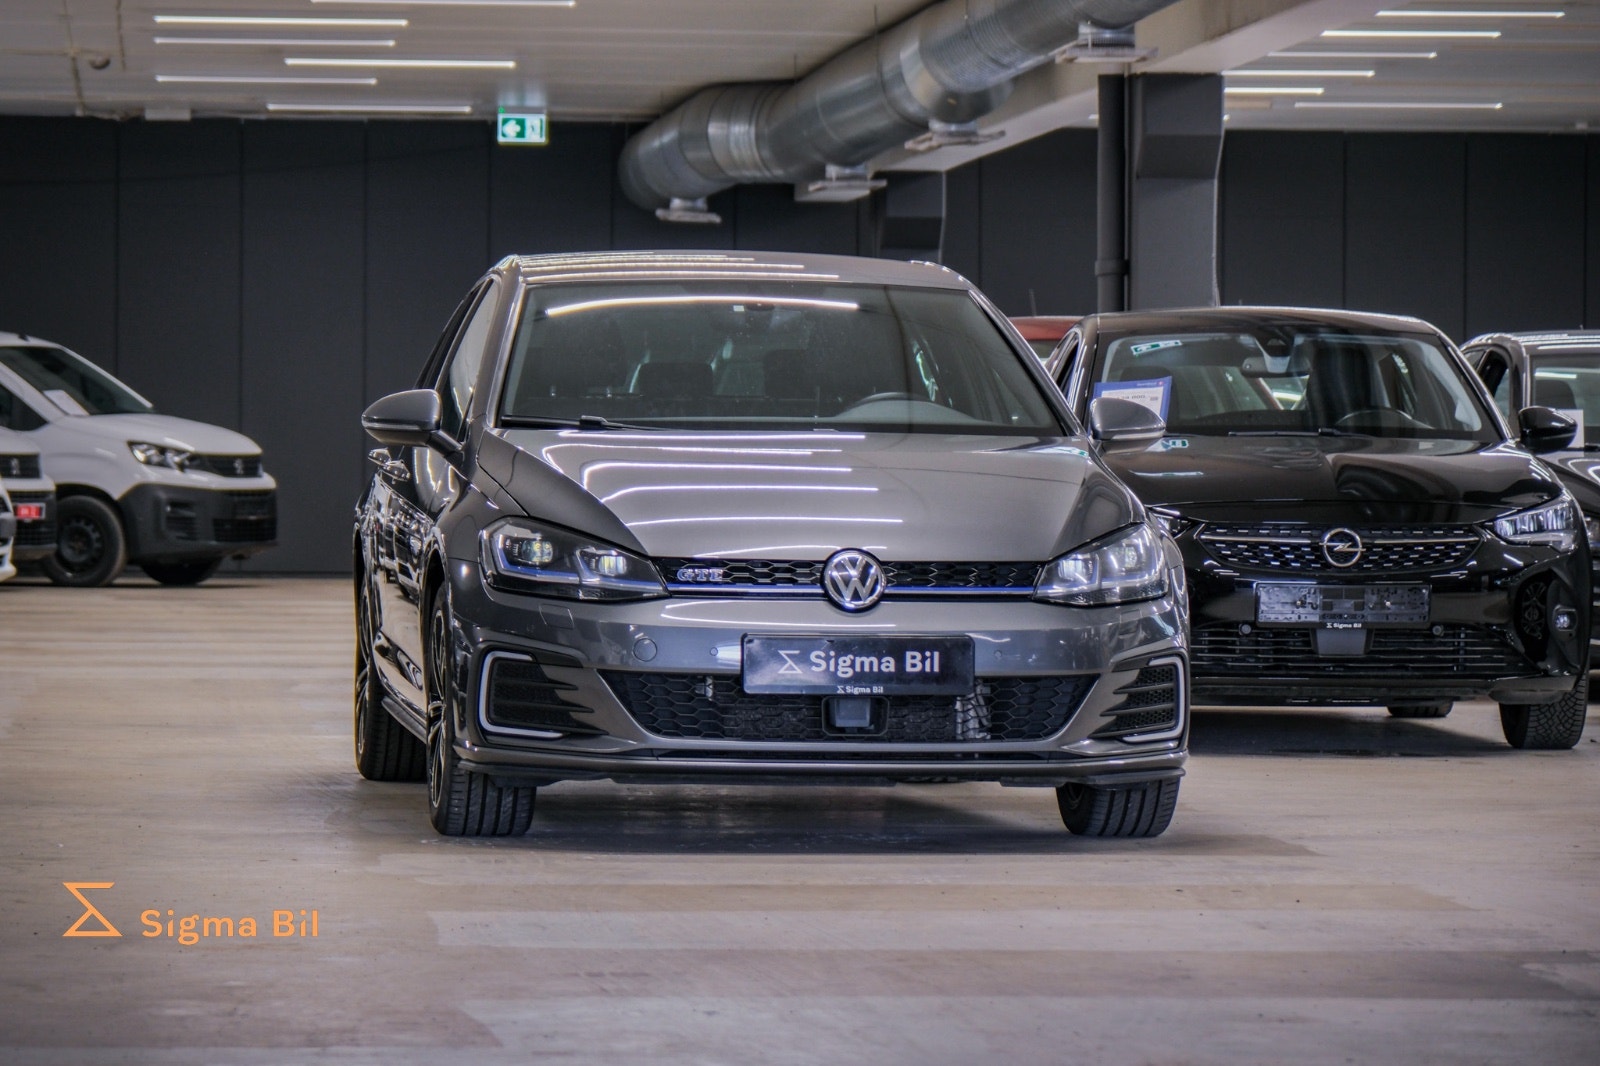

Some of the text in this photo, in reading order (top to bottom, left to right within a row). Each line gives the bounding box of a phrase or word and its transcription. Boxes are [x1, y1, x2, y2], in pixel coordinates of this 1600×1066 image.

[677, 568, 723, 581] GTE
[809, 650, 940, 677] Sigma Bil
[845, 685, 884, 695] Sigma Bil
